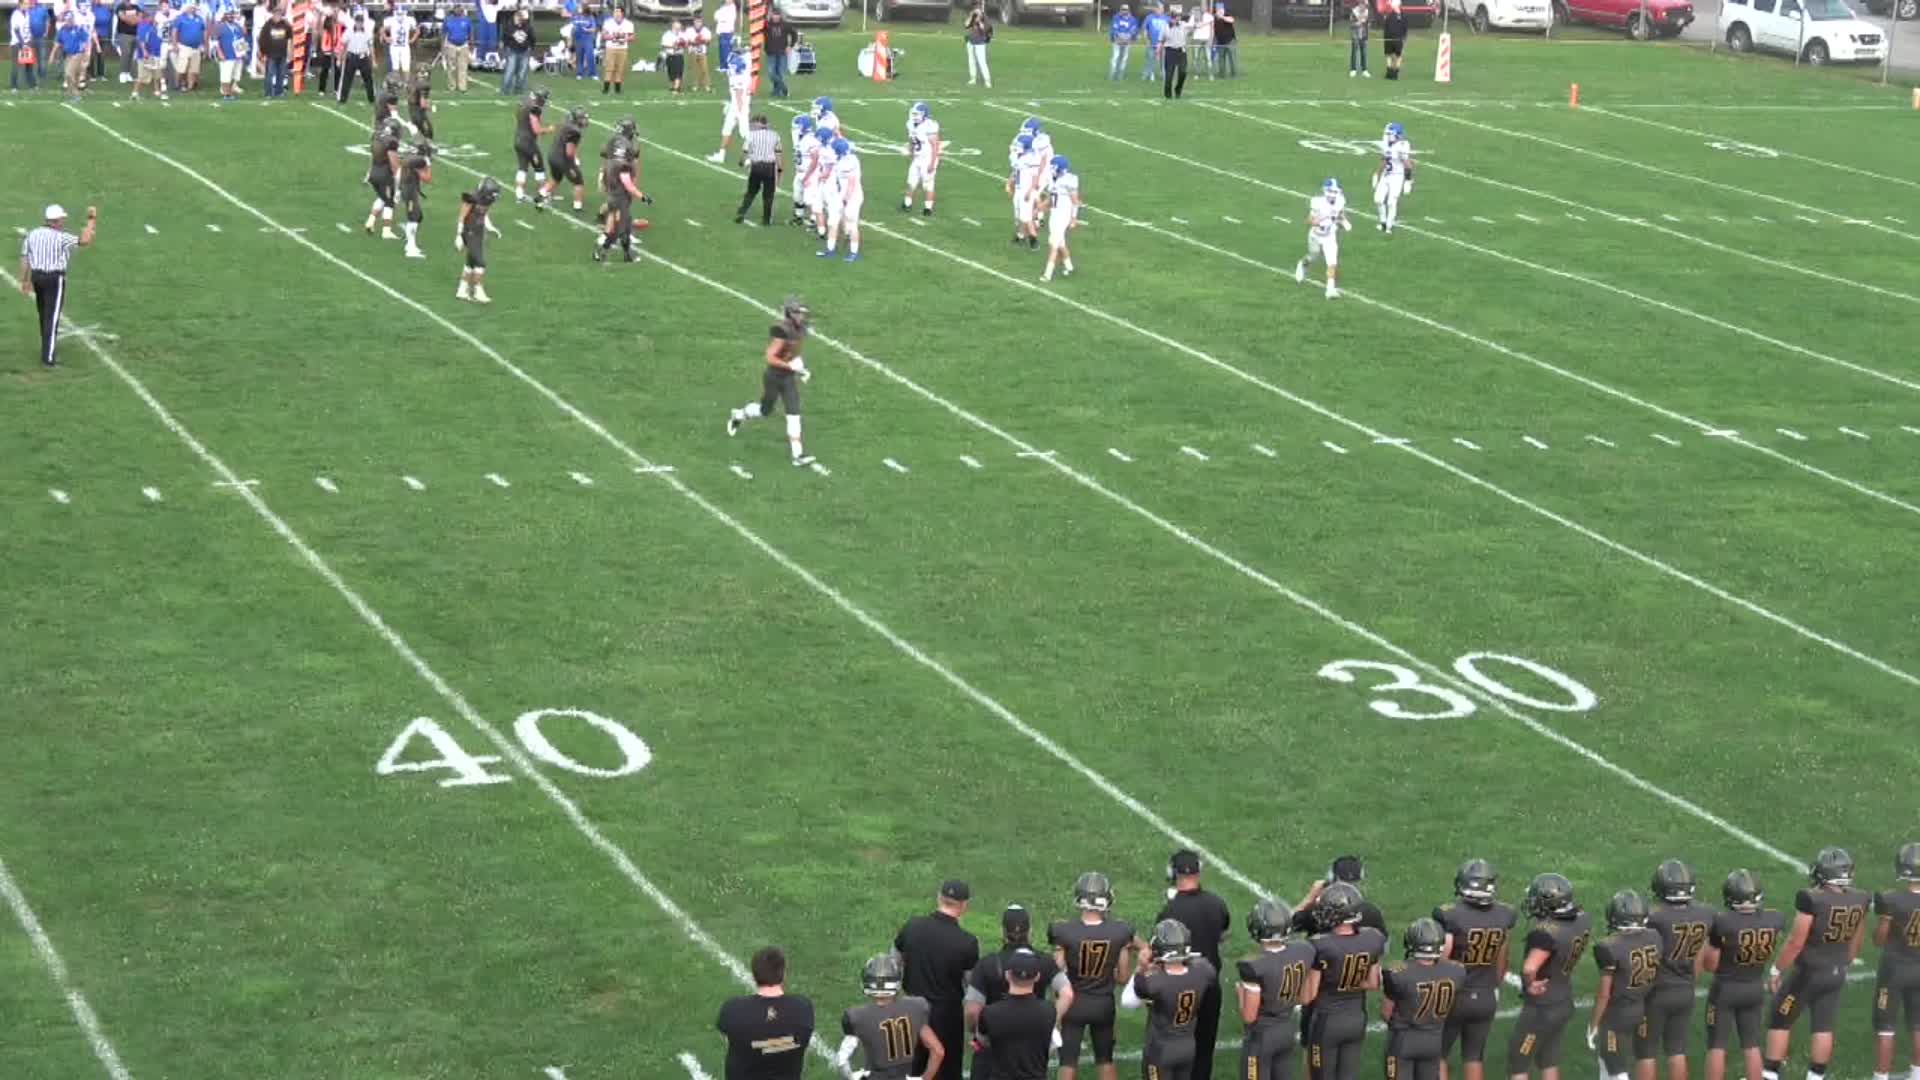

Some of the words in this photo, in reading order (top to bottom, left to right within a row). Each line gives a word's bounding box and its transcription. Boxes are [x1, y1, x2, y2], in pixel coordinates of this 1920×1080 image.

[1317, 652, 1598, 719] 30
[376, 707, 652, 787] 40
[1668, 920, 1708, 960] 72
[1823, 904, 1864, 944] 59
[1078, 940, 1111, 977] 17
[1463, 927, 1505, 966] 36
[1626, 944, 1660, 990] 25
[1337, 951, 1370, 992] 16
[1173, 989, 1196, 1027] 8
[1414, 977, 1456, 1023] 70
[879, 1016, 912, 1062] 11
